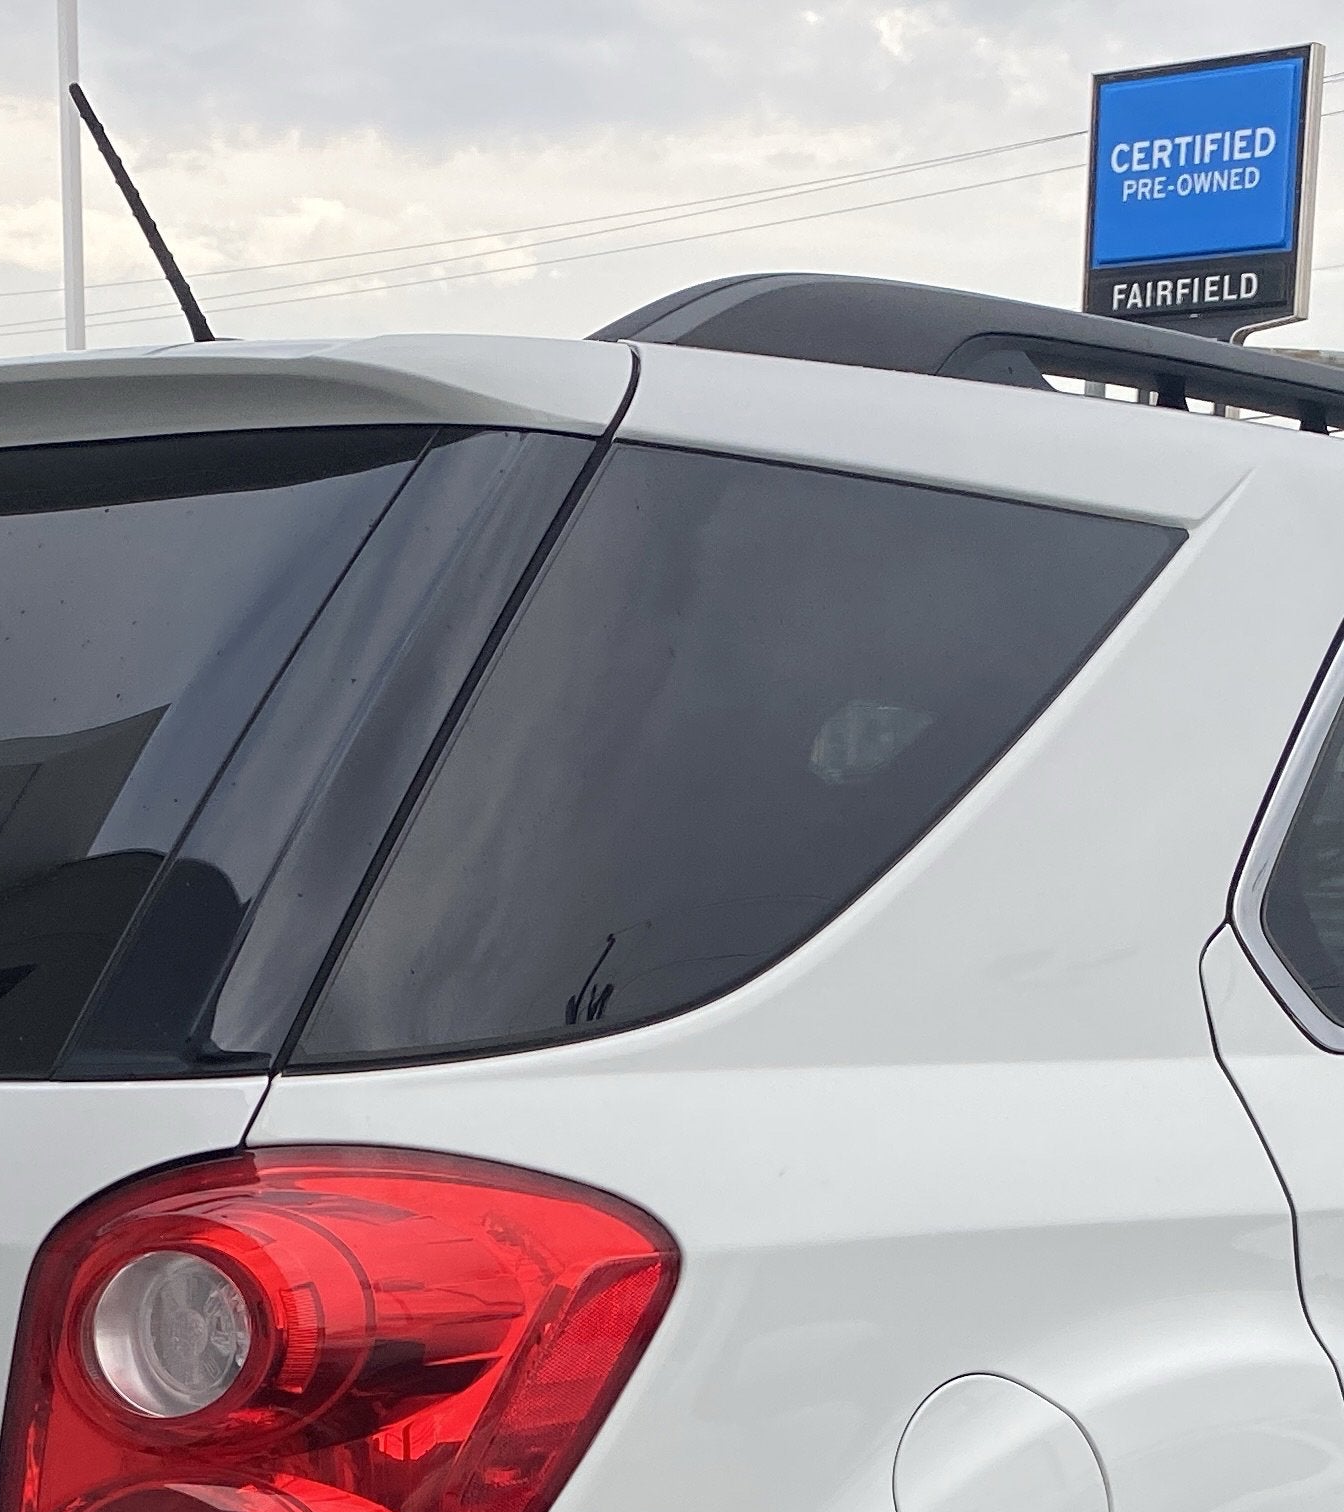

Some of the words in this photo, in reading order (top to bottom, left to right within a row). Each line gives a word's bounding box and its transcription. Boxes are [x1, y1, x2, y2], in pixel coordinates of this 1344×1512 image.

[1110, 126, 1277, 174] CERTIFIED
[1121, 166, 1261, 203] PRE-OWNED
[1111, 272, 1259, 311] FAIRFIELD
